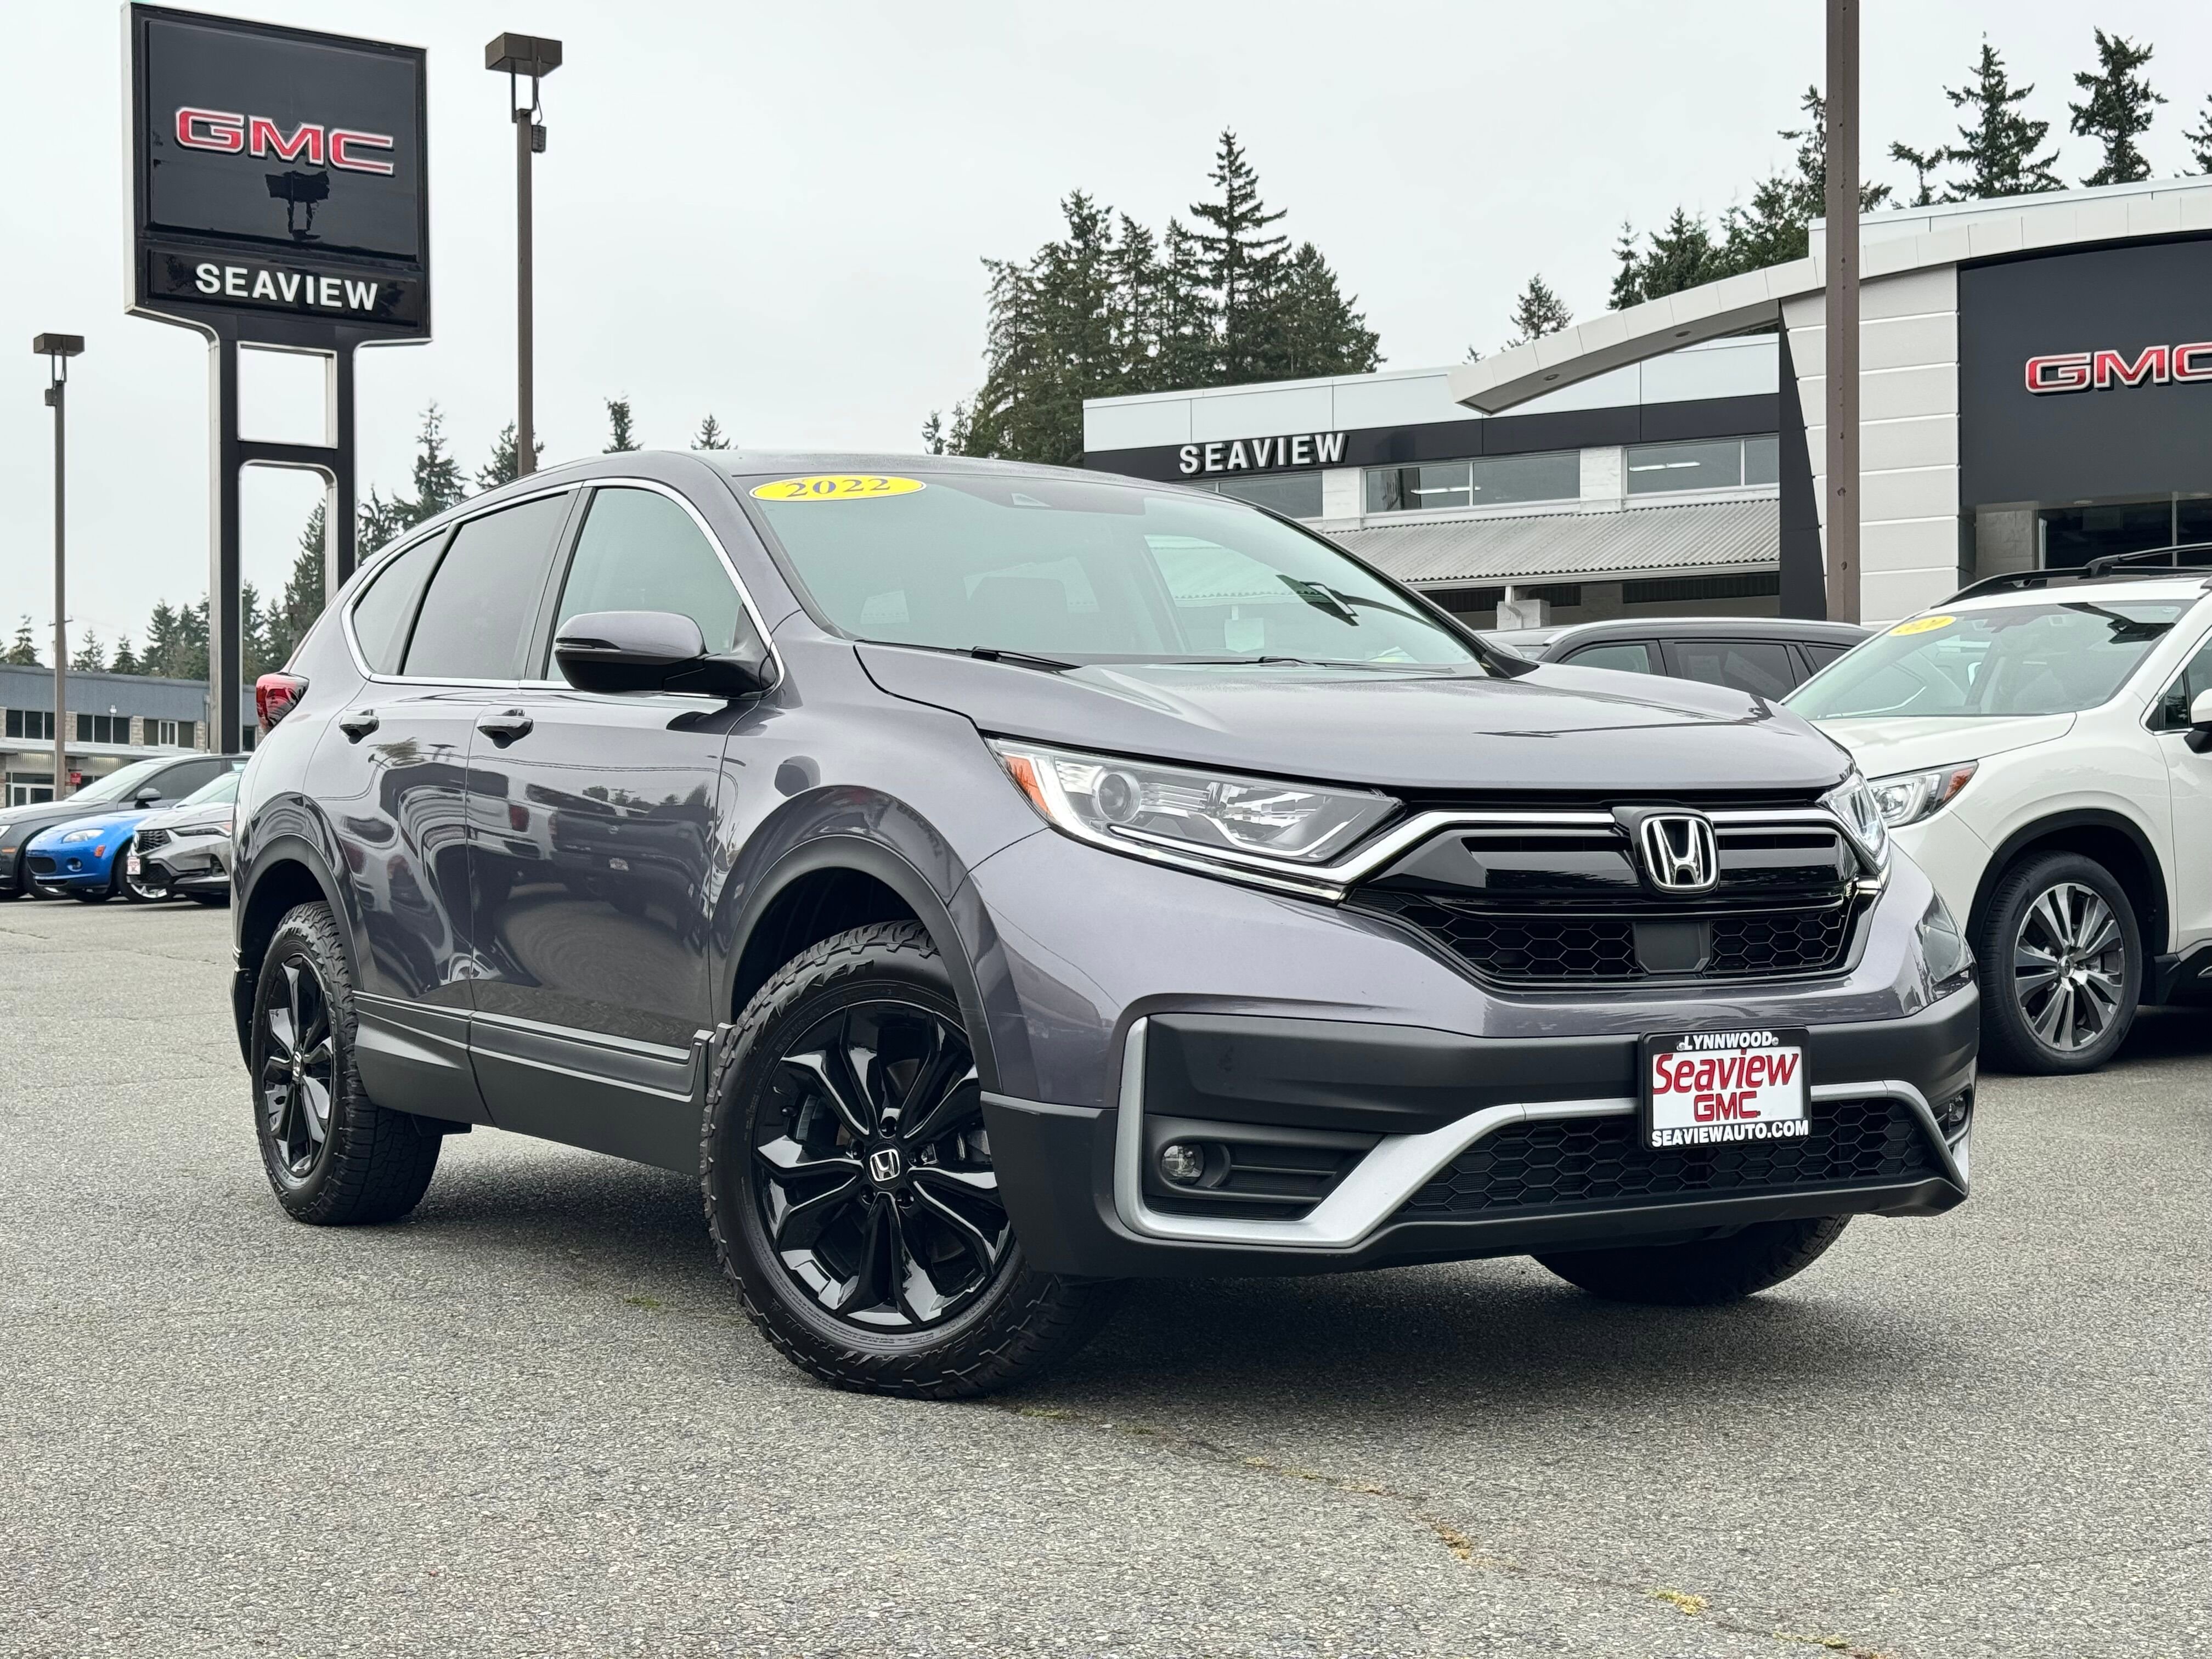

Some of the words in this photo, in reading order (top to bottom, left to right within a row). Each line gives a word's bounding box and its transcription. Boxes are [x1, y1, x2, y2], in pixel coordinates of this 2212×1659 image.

[175, 106, 394, 176] GMC
[195, 263, 379, 312] SEAVIEW
[1180, 432, 1346, 476] SEAVIEW
[785, 478, 891, 497] 2022
[1685, 1031, 1773, 1051] LYNNWOOD
[1652, 1048, 1799, 1095] Seaview
[1694, 1090, 1757, 1122] GMC
[1651, 1120, 1809, 1148] SEAVIEWAUTO.COM
